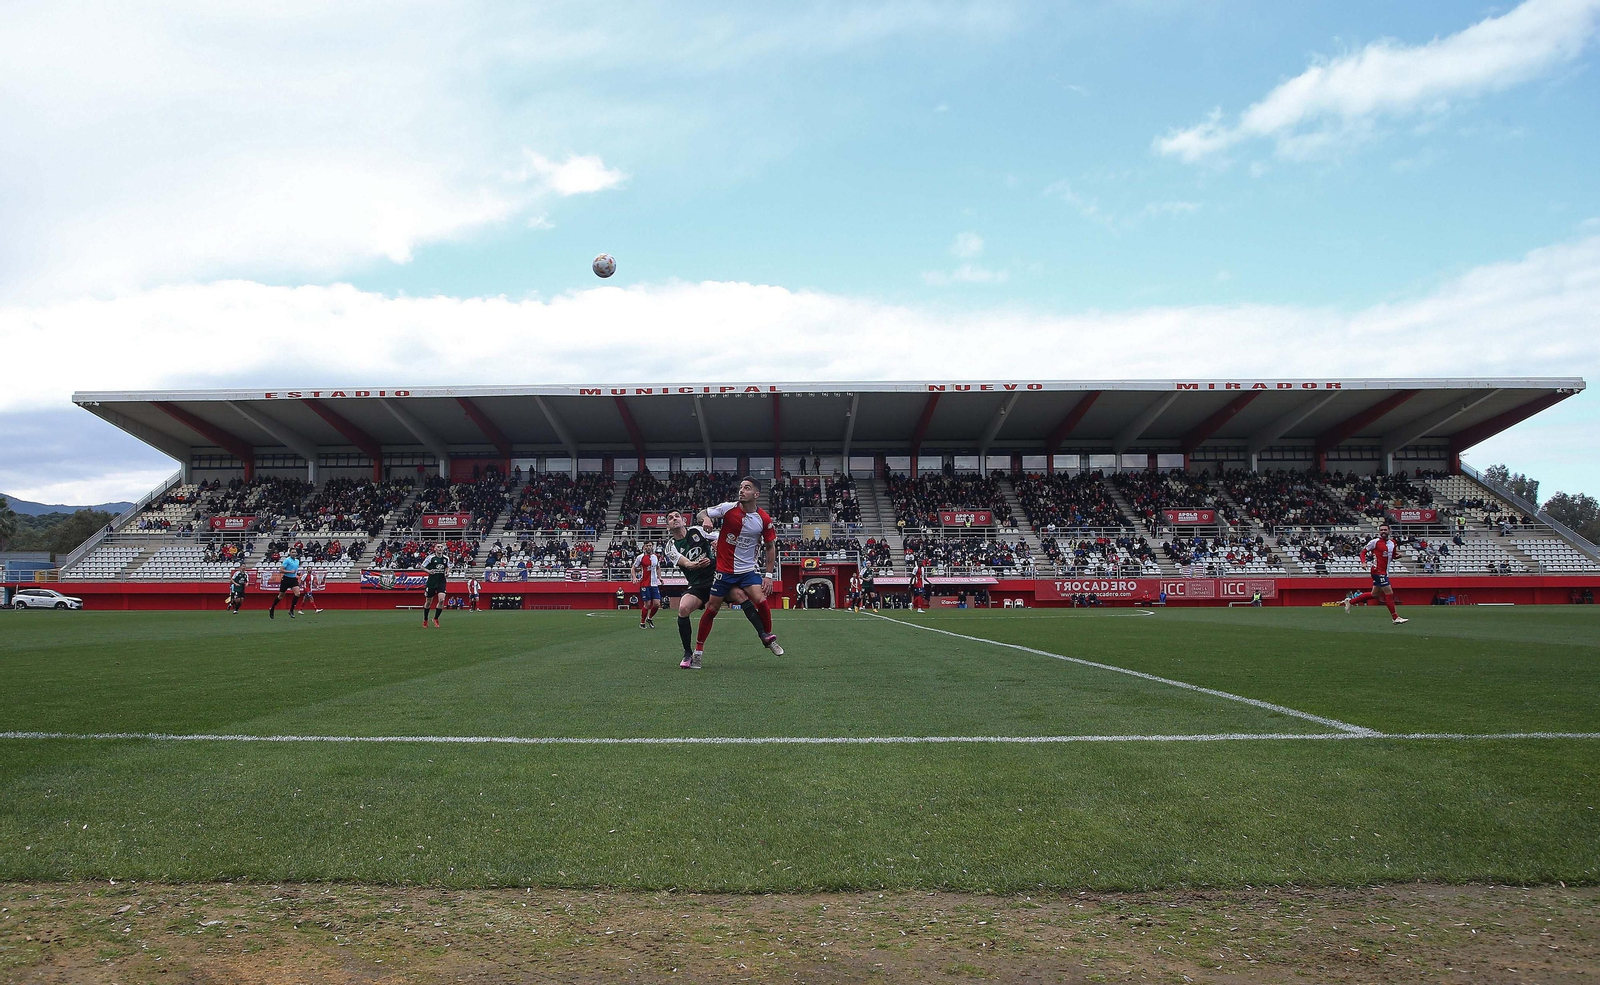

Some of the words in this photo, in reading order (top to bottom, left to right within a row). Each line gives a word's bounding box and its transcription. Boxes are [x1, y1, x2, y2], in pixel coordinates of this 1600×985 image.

[579, 385, 782, 395] MUNICIPAL
[1163, 583, 1185, 595] ICC
[1223, 583, 1245, 595] ICC
